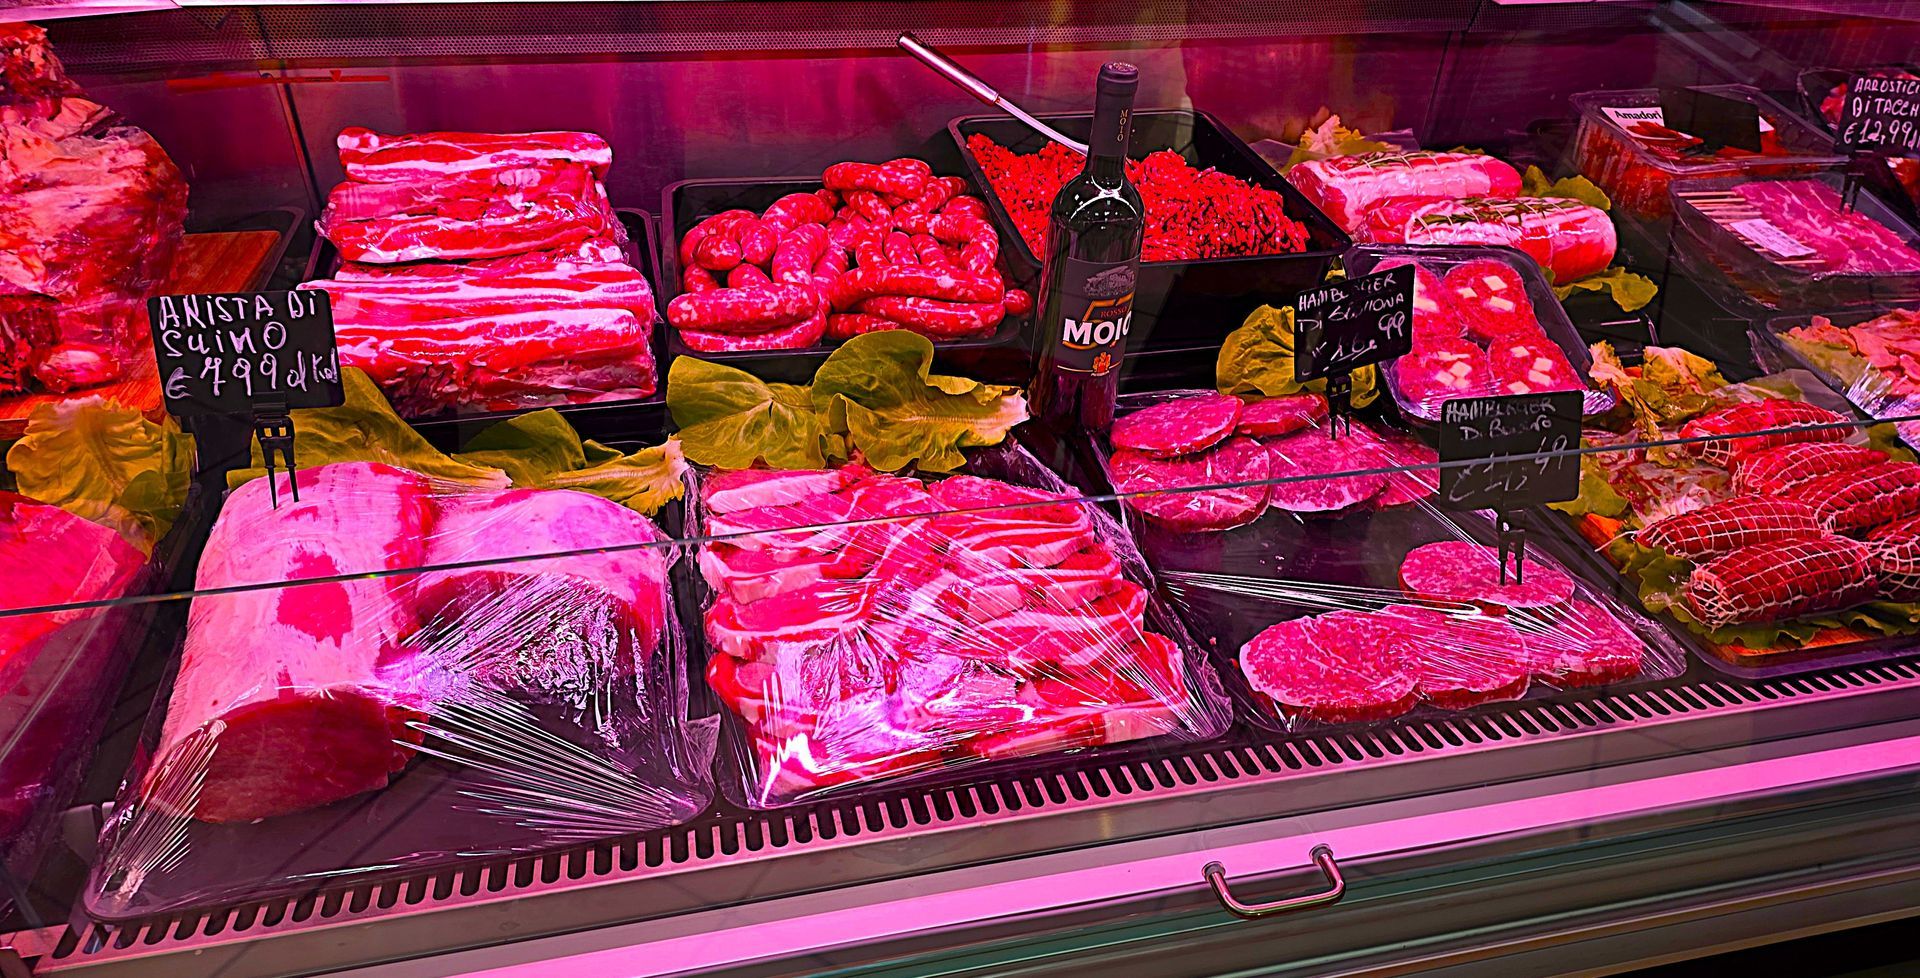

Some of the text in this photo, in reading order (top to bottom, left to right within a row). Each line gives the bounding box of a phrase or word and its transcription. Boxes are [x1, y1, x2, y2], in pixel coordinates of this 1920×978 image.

[1117, 109, 1129, 142] MOIO
[1615, 110, 1663, 120] Amadori
[1298, 272, 1397, 311] HAMBUGER
[1062, 310, 1132, 345] MOIO
